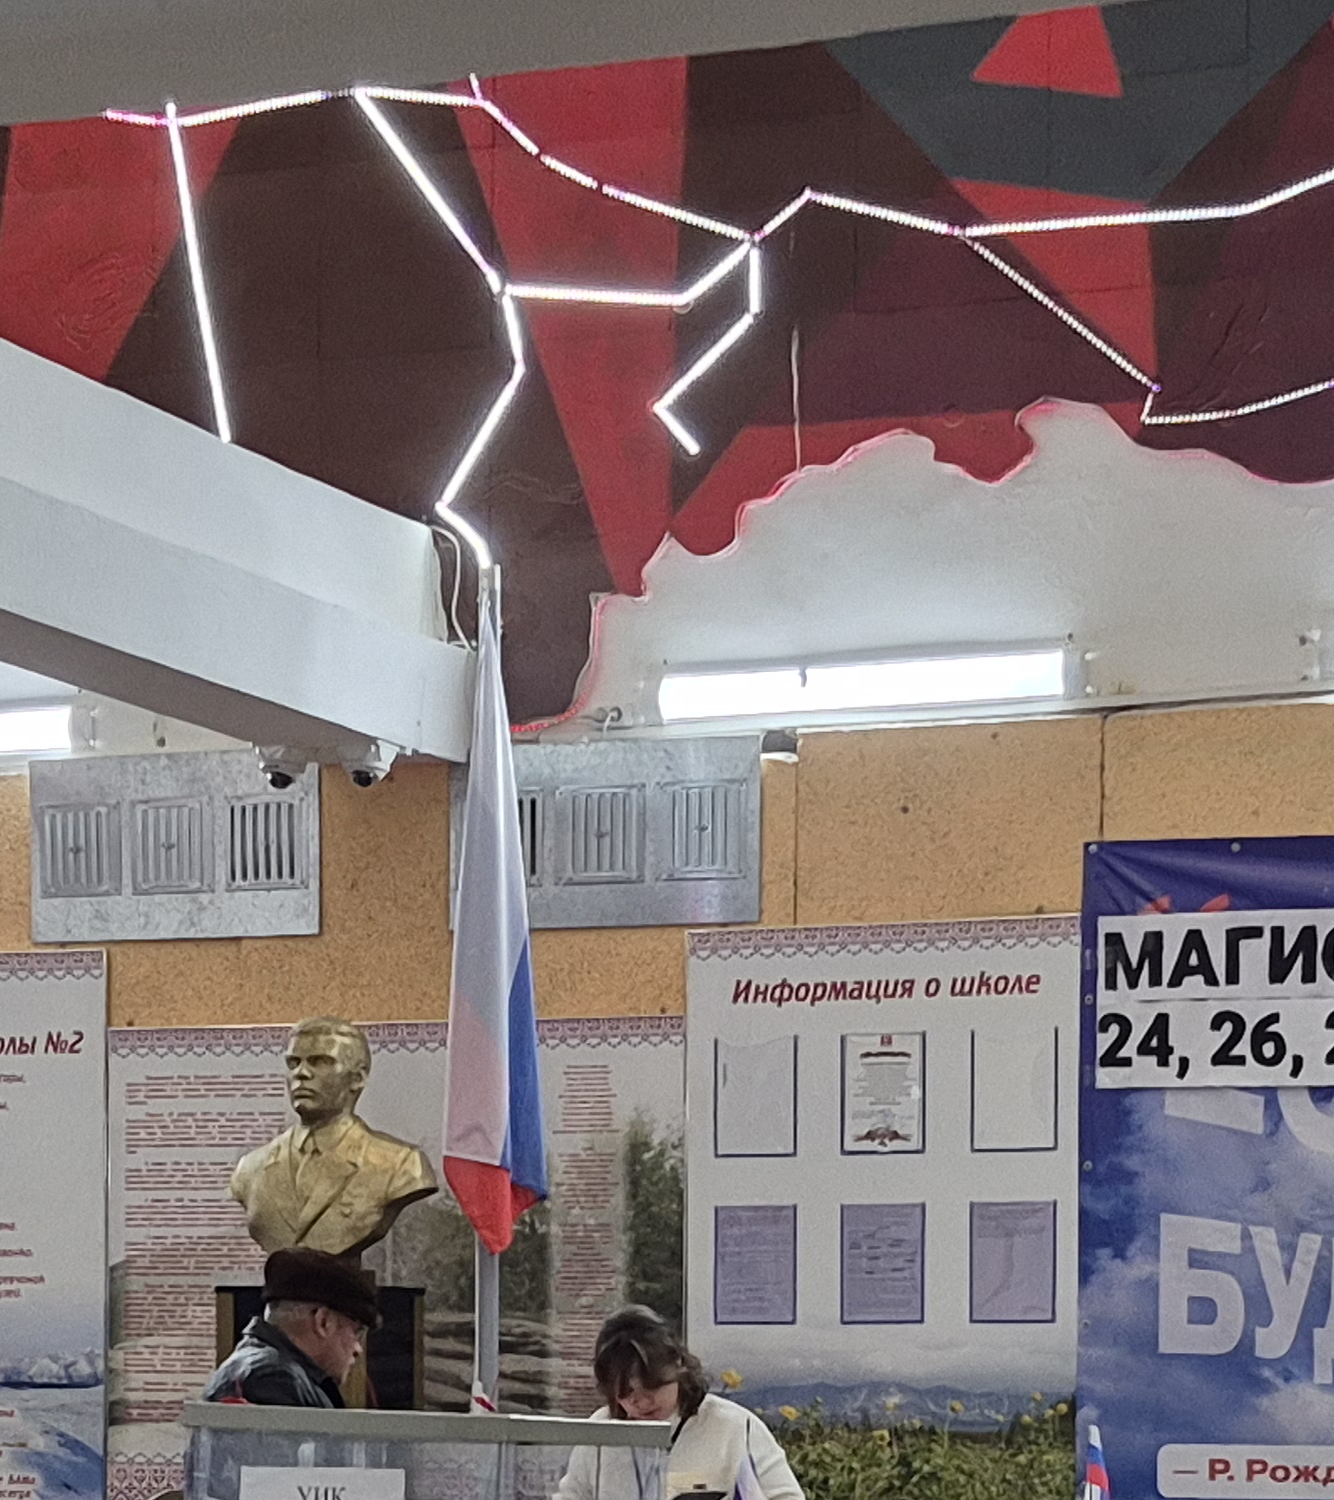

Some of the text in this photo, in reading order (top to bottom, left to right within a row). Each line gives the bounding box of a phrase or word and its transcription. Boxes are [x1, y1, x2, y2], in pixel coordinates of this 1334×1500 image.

[732, 971, 1042, 1008] Информация о школе
[43, 1031, 84, 1056] №2
[1097, 1012, 1191, 1079] 24,
[1209, 1010, 1305, 1077] 26,
[1207, 1458, 1235, 1482] Р.
